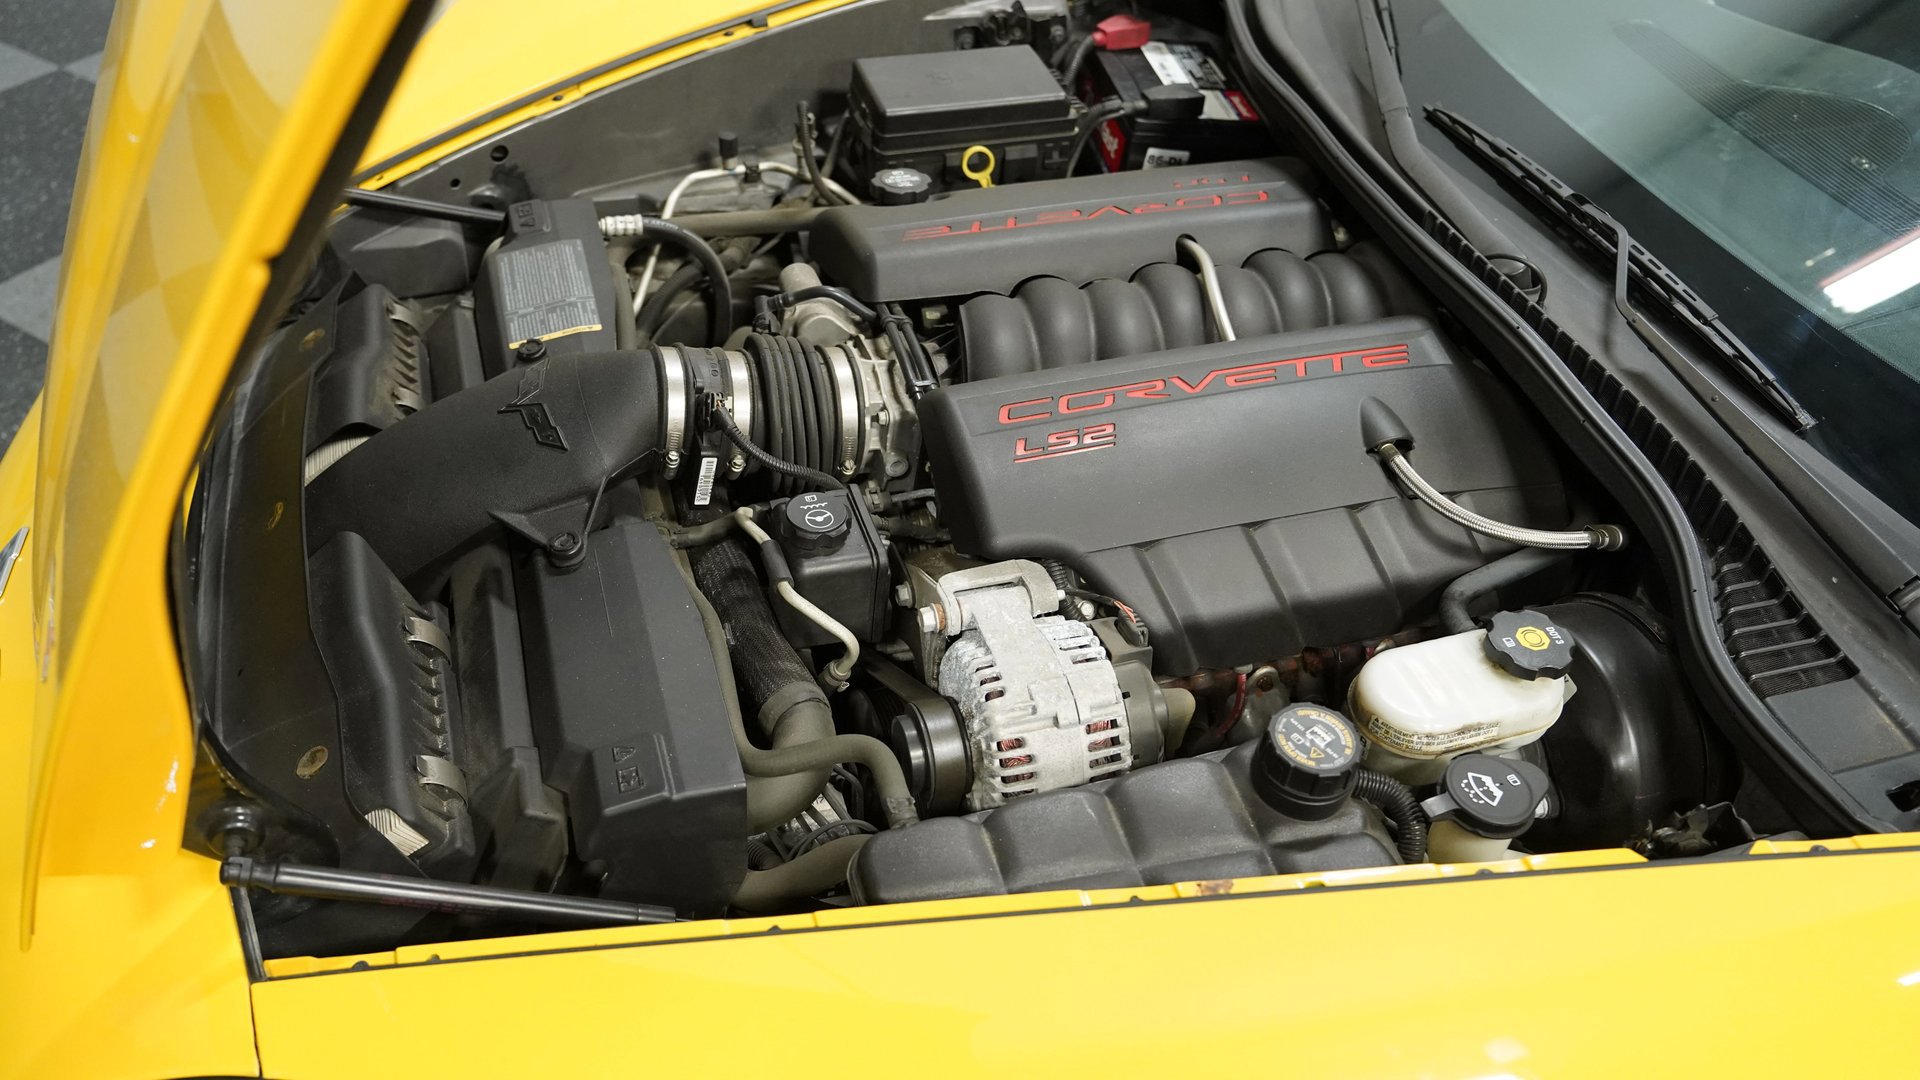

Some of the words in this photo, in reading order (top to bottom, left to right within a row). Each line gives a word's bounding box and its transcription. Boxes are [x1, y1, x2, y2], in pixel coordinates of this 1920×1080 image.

[903, 190, 1269, 241] CORVETTE
[999, 343, 1409, 424] CORVETTE
[1015, 422, 1116, 456] LS2
[1545, 626, 1561, 640] DOT
